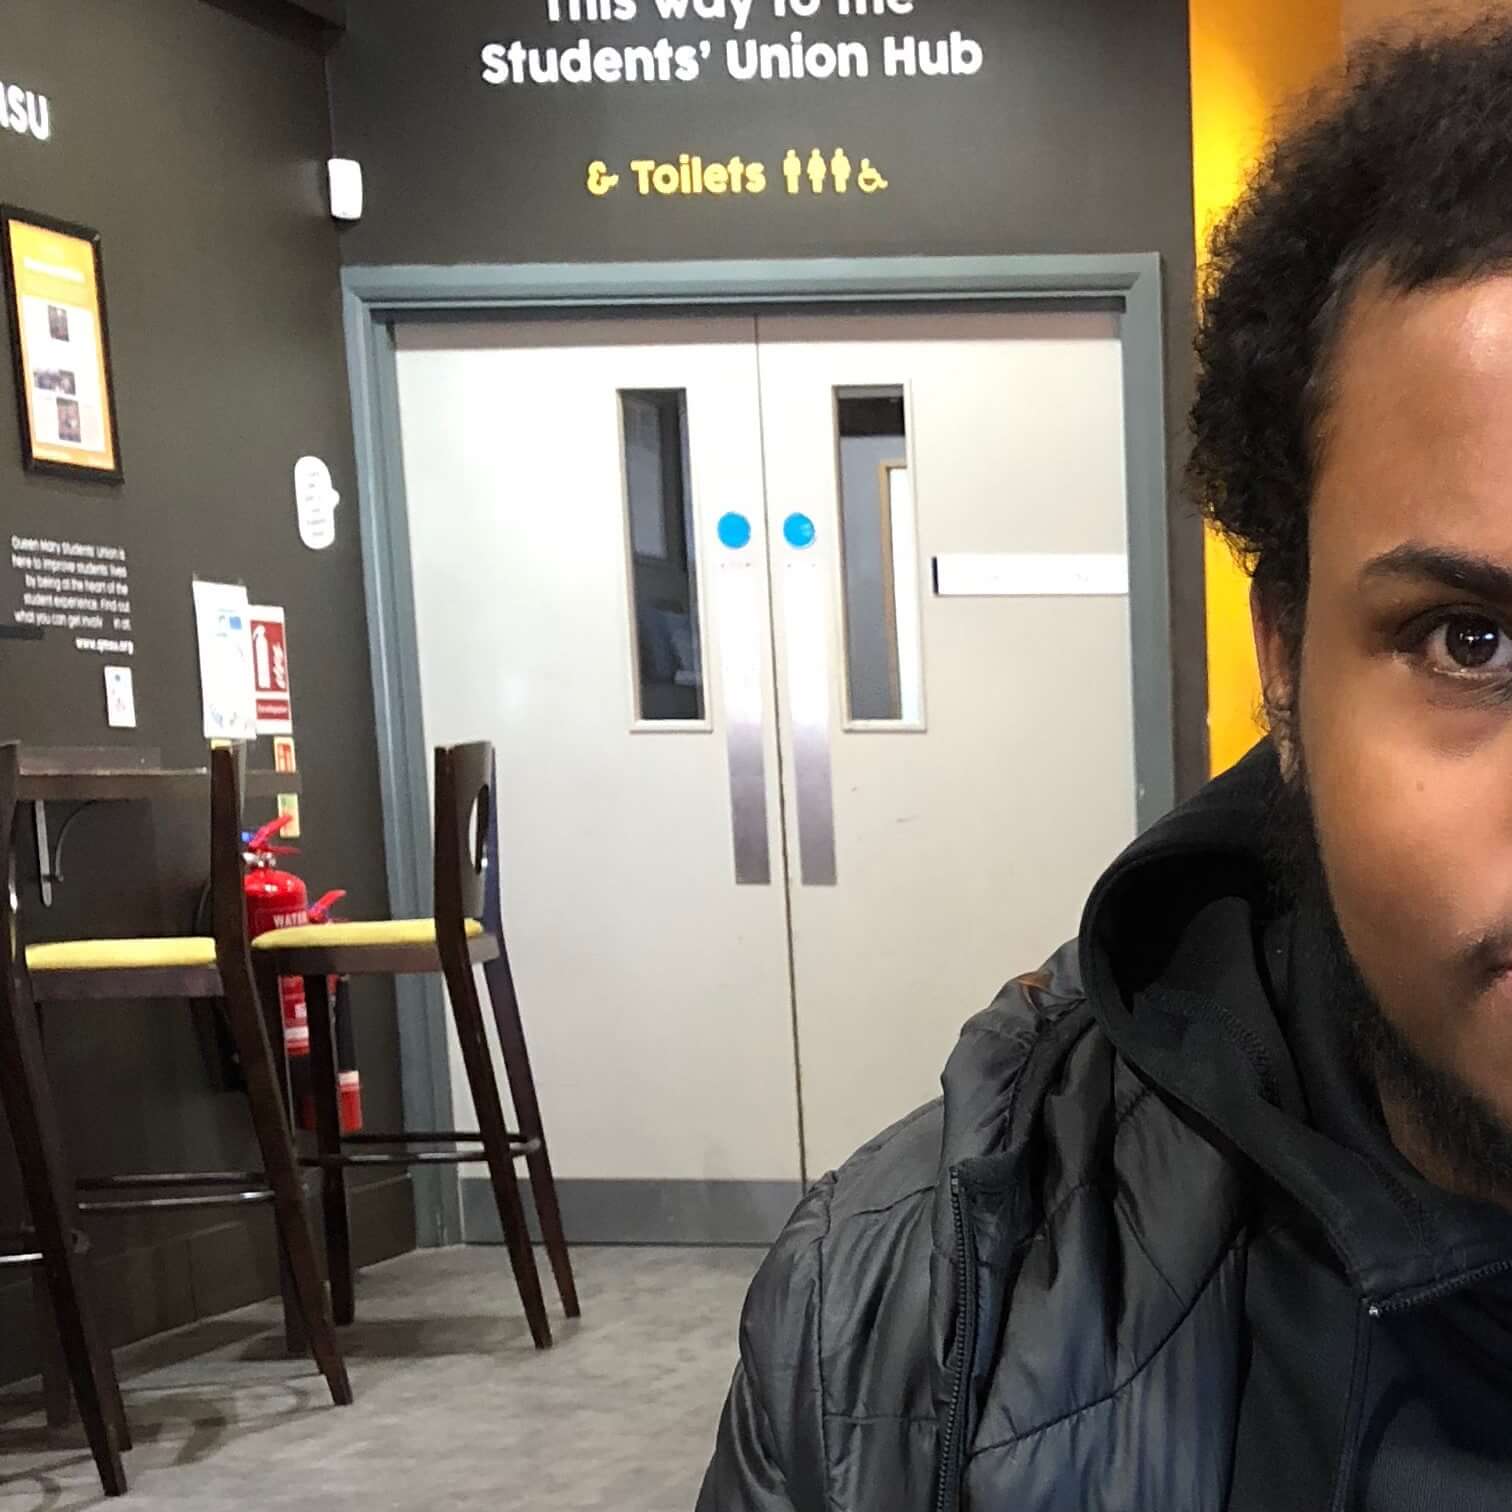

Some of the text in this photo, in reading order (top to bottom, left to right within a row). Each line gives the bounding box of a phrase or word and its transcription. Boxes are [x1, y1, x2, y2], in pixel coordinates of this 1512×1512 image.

[481, 30, 983, 85] Students' Union Hub
[0, 81, 49, 140] SU
[587, 153, 766, 195] & Toilets
